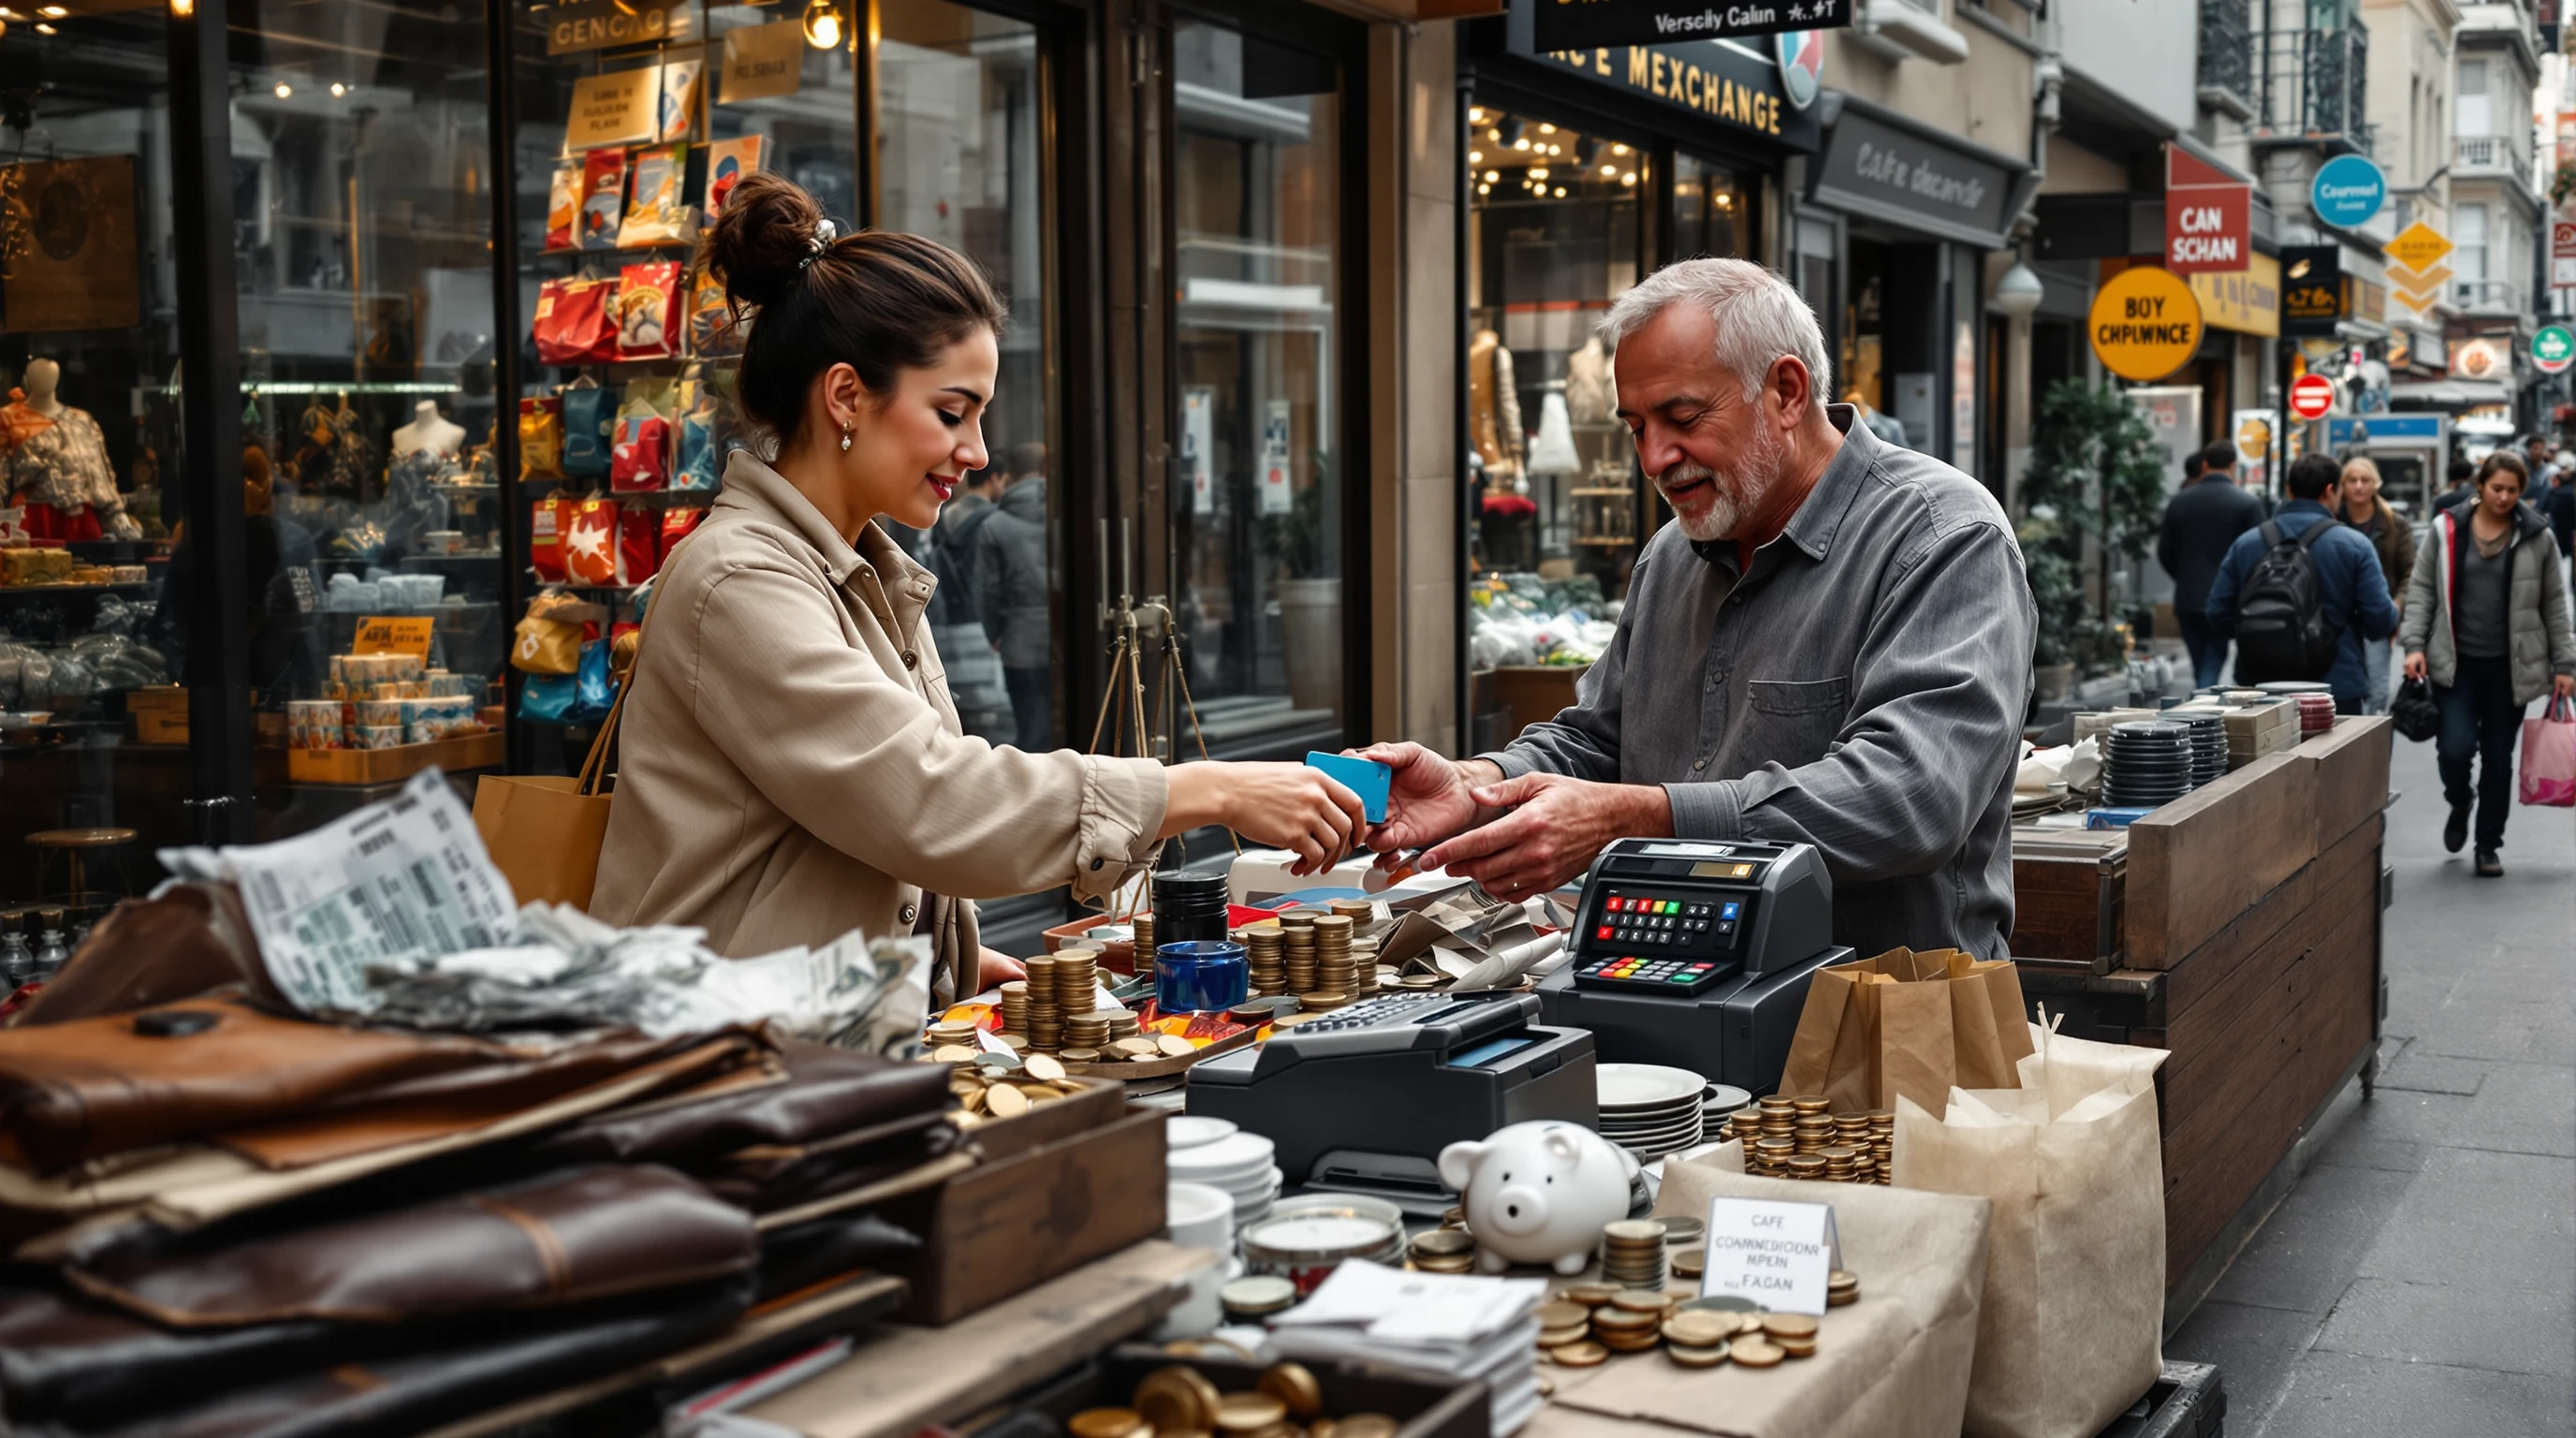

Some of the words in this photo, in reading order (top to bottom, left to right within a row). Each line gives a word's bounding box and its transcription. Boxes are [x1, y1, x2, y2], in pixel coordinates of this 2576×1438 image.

[1628, 45, 1781, 136] MEXCHANGE
[2179, 206, 2222, 234] CAN
[2173, 236, 2237, 263] SCHAN
[2125, 295, 2166, 319] BOY
[1751, 1214, 1786, 1229] CAFE
